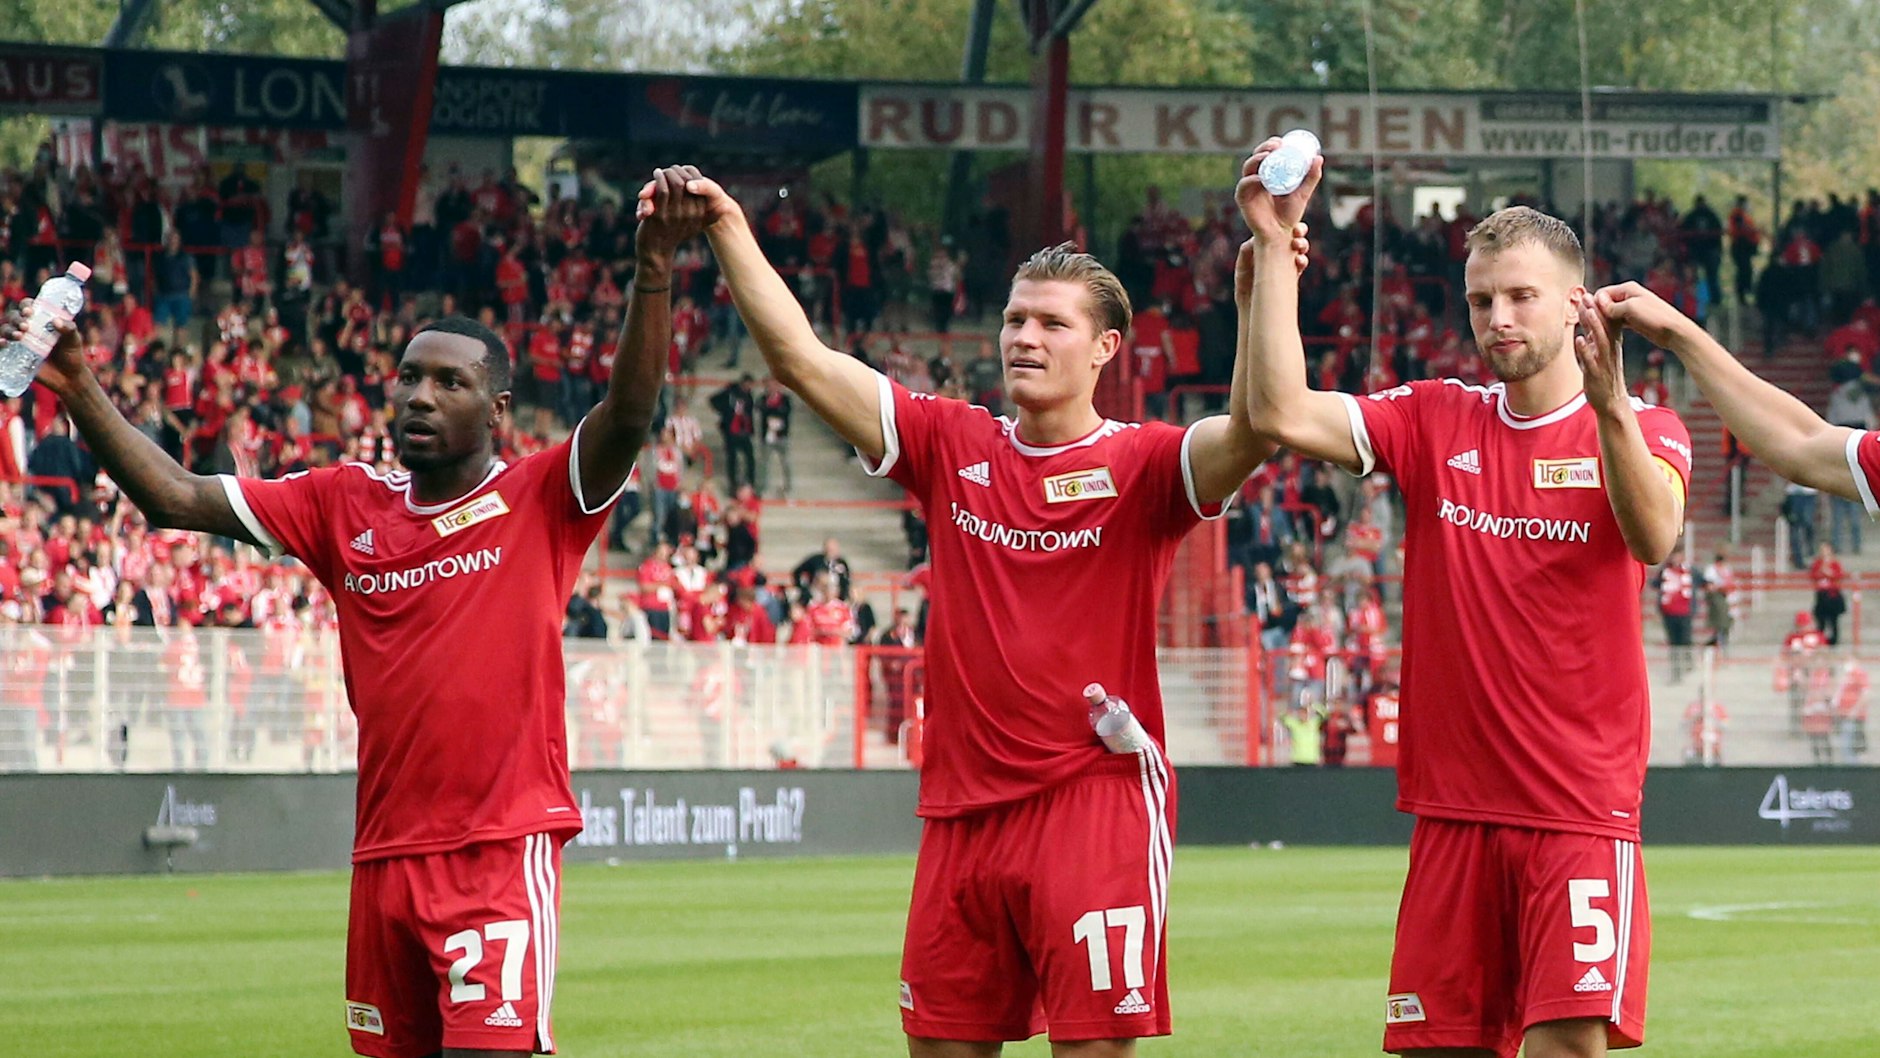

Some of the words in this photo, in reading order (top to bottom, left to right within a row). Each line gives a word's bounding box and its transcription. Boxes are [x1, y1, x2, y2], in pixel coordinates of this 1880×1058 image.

[867, 97, 1121, 147] RUDR
[1155, 96, 1465, 152] KÜCHEN
[1480, 124, 1766, 152] www.m-ruder.de
[951, 501, 1102, 551] ROUNDTOWN
[1437, 496, 1591, 543] ROUNDTOWN
[344, 546, 501, 595] AOUNDTOWN
[619, 787, 688, 845] Talent
[691, 805, 736, 844] zum
[739, 786, 806, 843] Profi?
[1568, 878, 1616, 963] 5
[444, 919, 530, 1004] 27
[1072, 905, 1147, 991] 17
[1114, 1003, 1151, 1014] adidas
[1574, 981, 1612, 992] adidas
[484, 1016, 523, 1027] adidas
